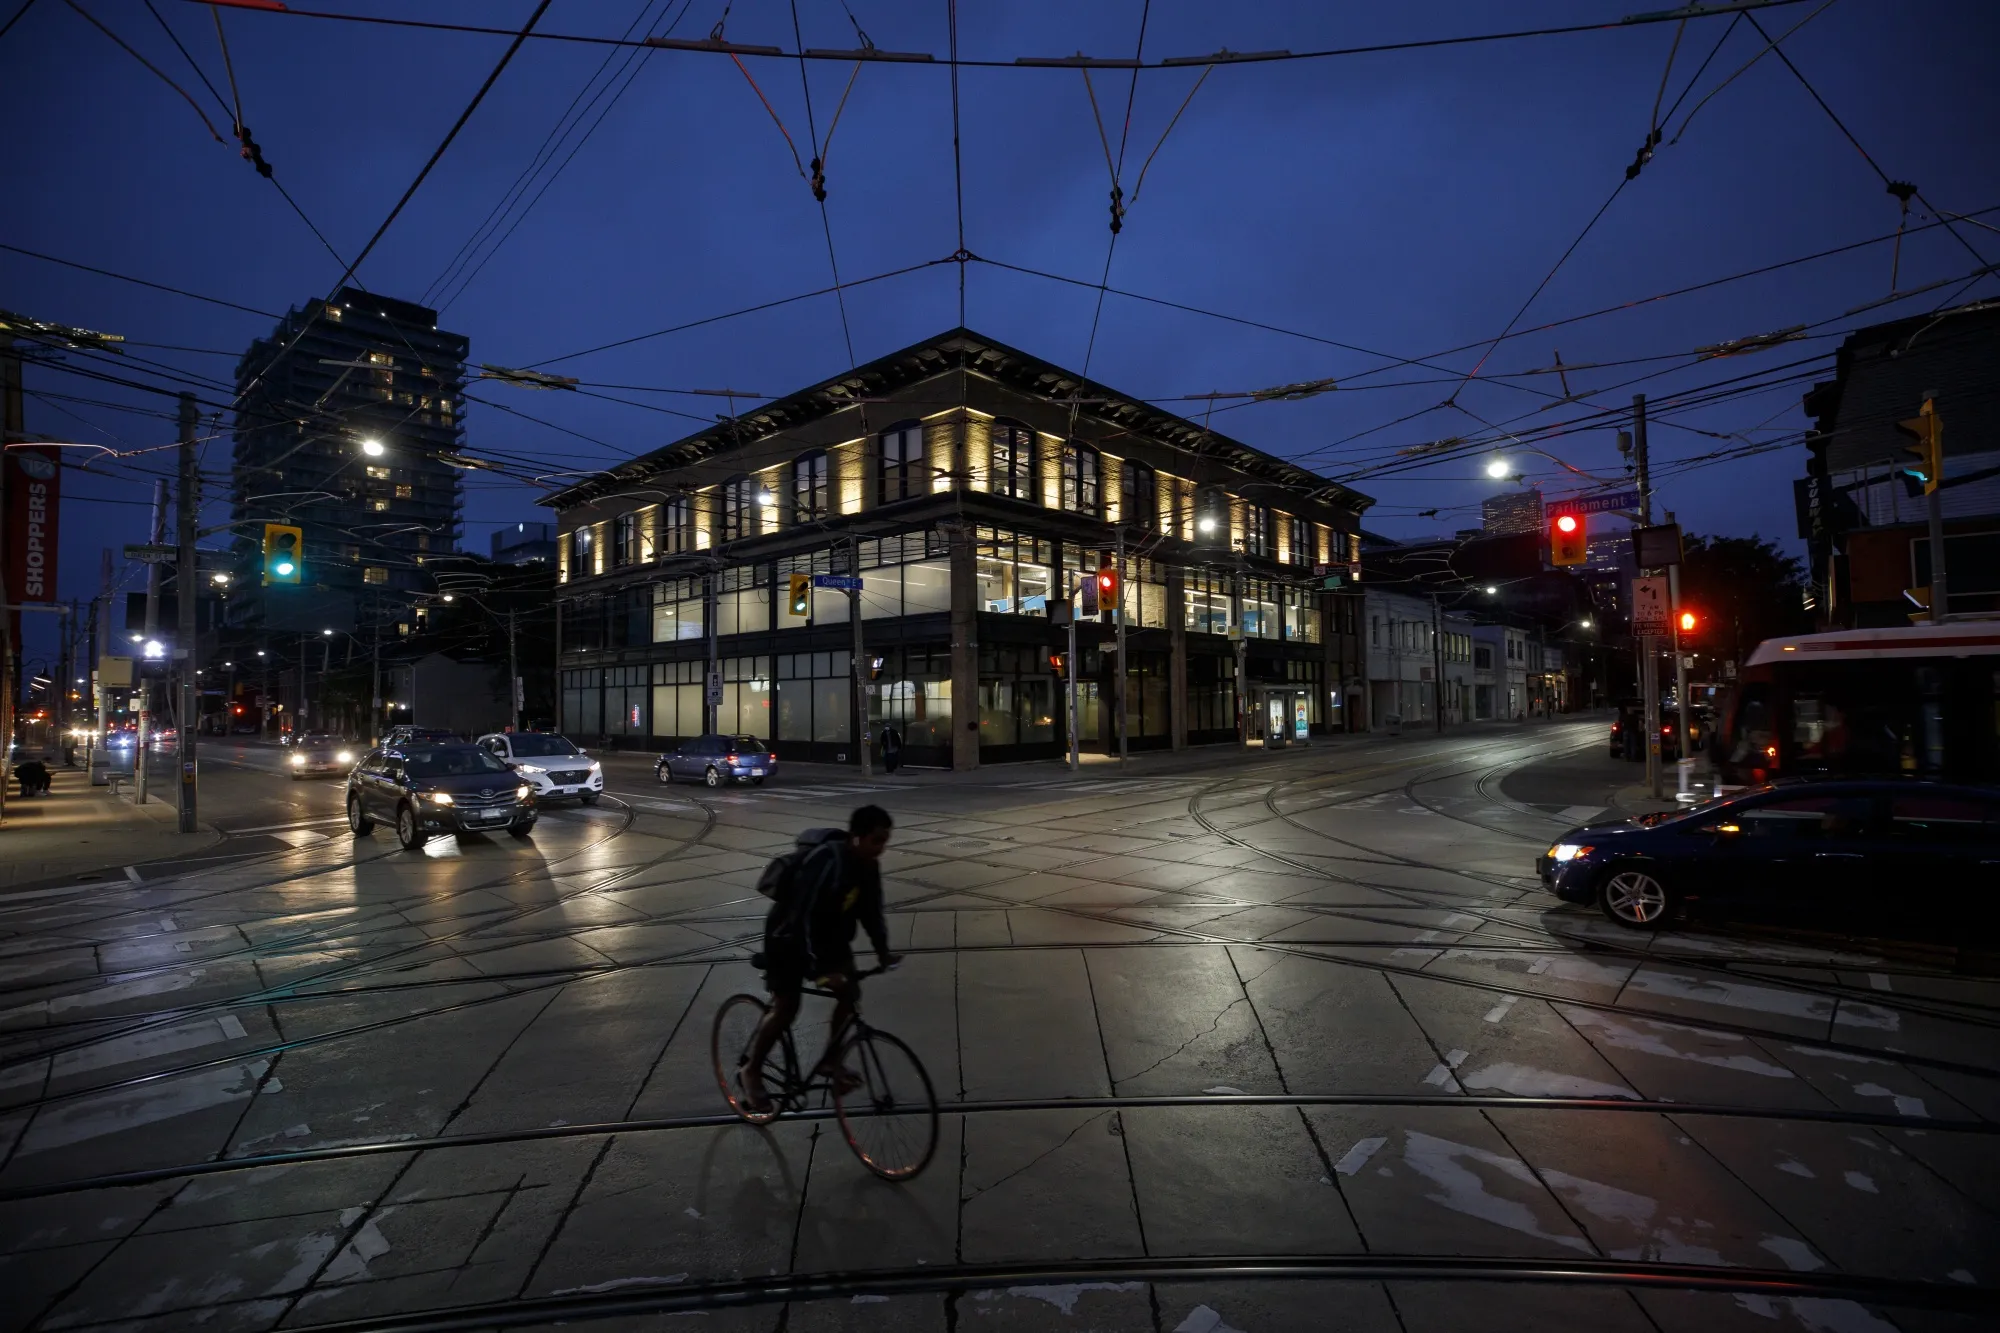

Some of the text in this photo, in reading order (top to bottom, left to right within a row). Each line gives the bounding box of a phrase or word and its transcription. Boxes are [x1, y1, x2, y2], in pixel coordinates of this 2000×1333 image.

[1546, 495, 1626, 515] Parliament
[25, 482, 47, 597] SHOPPERS
[822, 576, 846, 586] Queen
[852, 578, 857, 587] E
